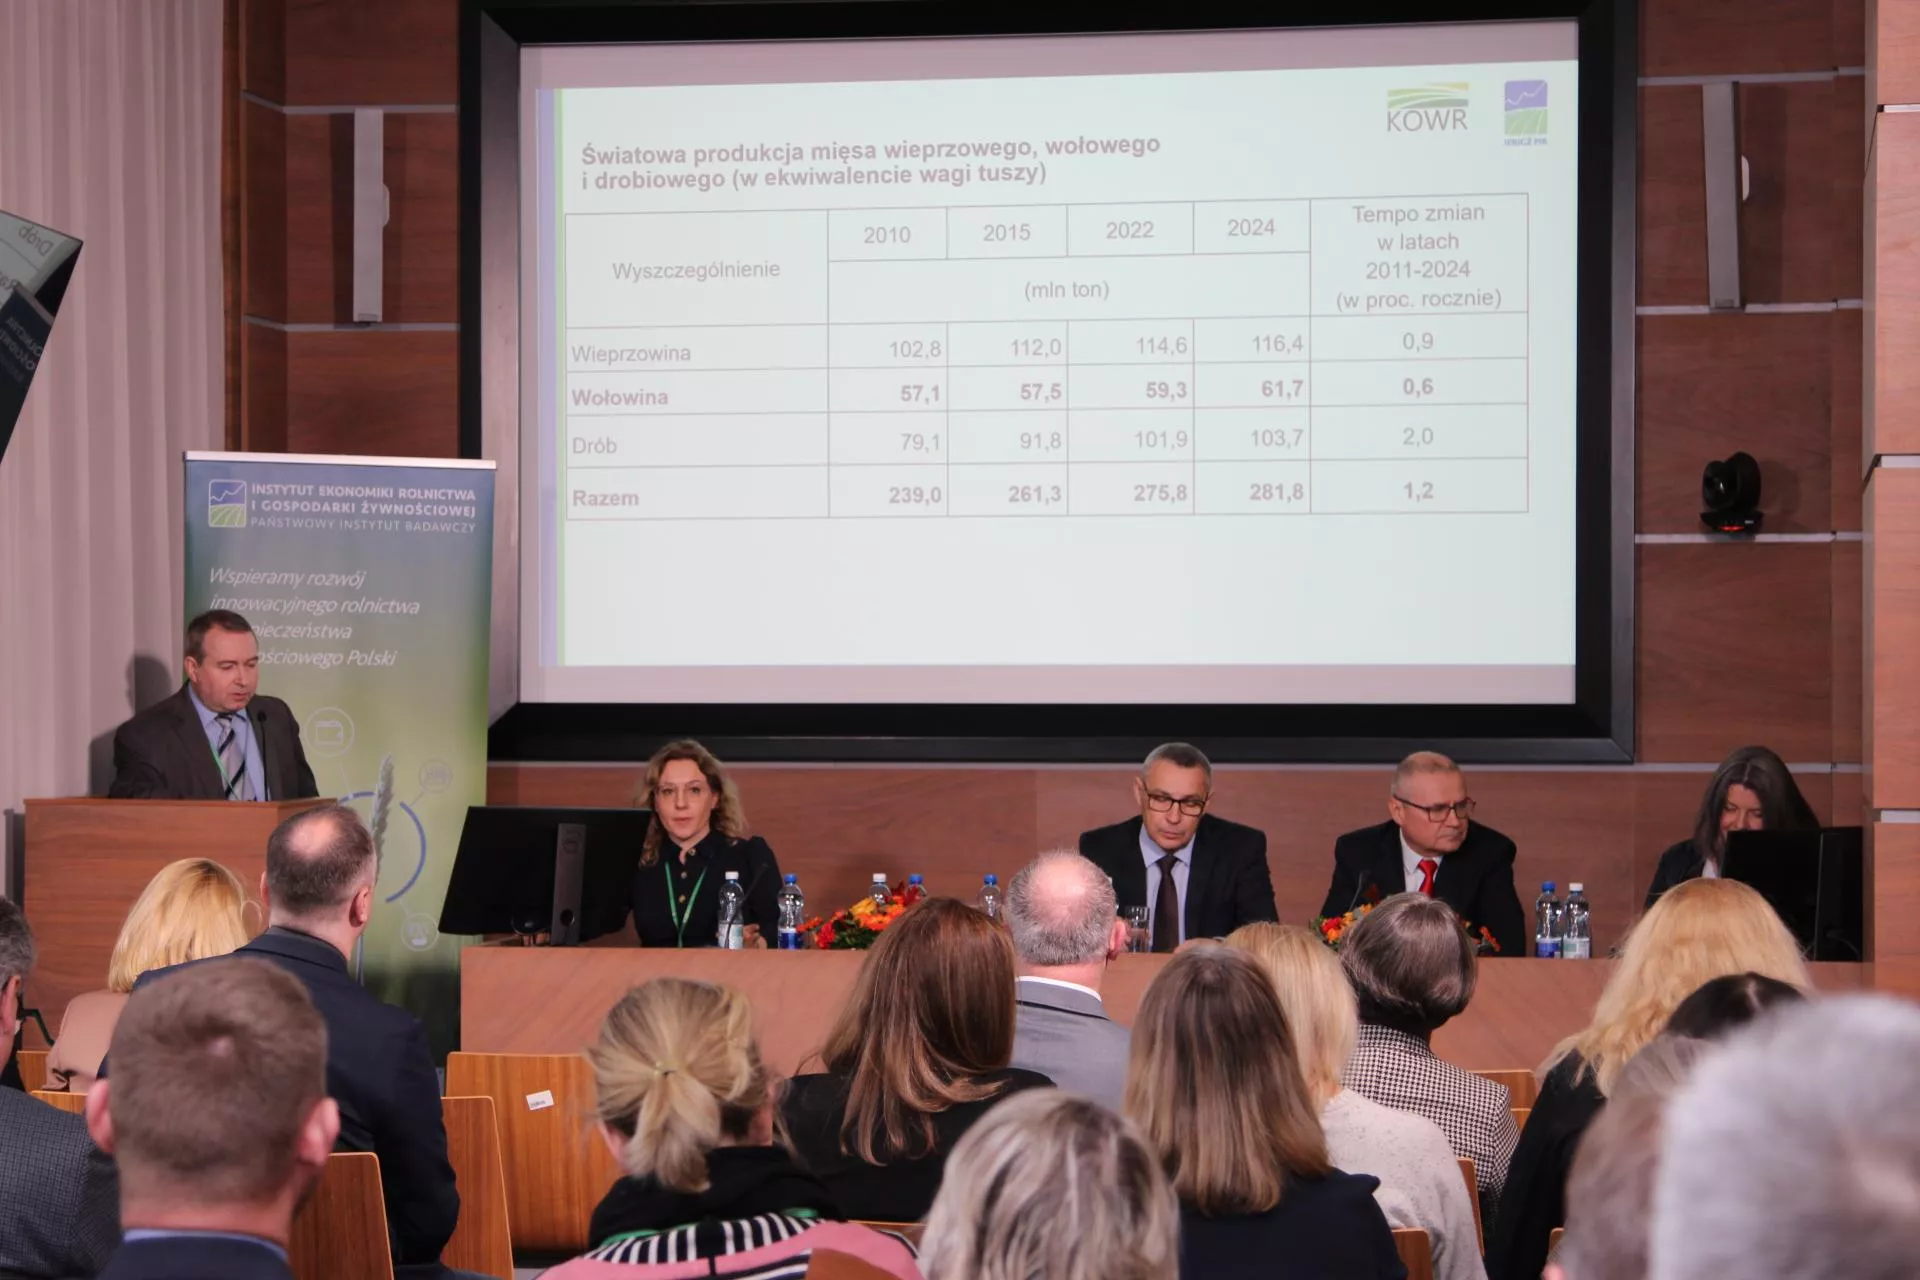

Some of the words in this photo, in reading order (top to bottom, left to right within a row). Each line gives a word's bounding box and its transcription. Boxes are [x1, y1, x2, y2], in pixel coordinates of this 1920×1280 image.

[1387, 109, 1468, 132] KOWR
[582, 141, 685, 165] Światowa
[694, 143, 804, 167] produkcja
[812, 141, 876, 162] mięsa
[884, 138, 1037, 162] wieprzowego,
[1046, 136, 1161, 157] wołowego
[582, 173, 588, 189] i
[595, 170, 725, 191] drobiowego
[733, 169, 758, 191] (w
[765, 167, 911, 186] ekwiwalencie
[920, 165, 971, 186] wagi
[978, 163, 1046, 186] tuszy)
[1353, 206, 1418, 226] Tempo
[1426, 205, 1485, 222] zmian
[864, 226, 910, 244] 2010
[983, 224, 1030, 241] 2015
[1106, 222, 1154, 239] 2022
[1227, 219, 1275, 236] 2024
[1378, 237, 1393, 251] w
[1400, 233, 1459, 251] latach
[612, 260, 780, 282] Wyszczególnienie
[1366, 261, 1470, 280] 2011-2024
[1024, 281, 1065, 302] (mln
[1072, 280, 1109, 300] ton)
[1337, 292, 1359, 312] (w
[1366, 291, 1415, 309] proc.
[1422, 288, 1502, 309] rocznie)
[889, 341, 942, 360] 102,8
[1011, 338, 1061, 359] 112,0
[1136, 337, 1187, 356] 114,6
[1252, 335, 1303, 354] 116,4
[1403, 333, 1434, 352] 0,9
[572, 344, 691, 365] Wieprzowina
[900, 385, 940, 404] 57,1
[1020, 383, 1061, 403] 57,5
[1146, 381, 1187, 400] 59,3
[1262, 380, 1303, 399] 61,7
[1403, 378, 1434, 397] 0,6
[572, 389, 669, 406] Wołowina
[572, 437, 617, 455] Drób
[901, 433, 940, 452] 79,1
[1019, 431, 1061, 452] 91,8
[1134, 431, 1188, 450] 101,9
[1250, 429, 1303, 449] 103,7
[1403, 427, 1434, 447] 2,0
[252, 484, 314, 496] INSTYTUT
[319, 485, 394, 498] EKONOMIKI
[399, 488, 475, 501] ROLNICTWA
[572, 489, 638, 507] Razem
[889, 486, 942, 505] 239,0
[1009, 486, 1061, 506] 261,3
[1134, 484, 1187, 502] 275,8
[1250, 483, 1303, 502] 281,8
[1404, 482, 1434, 500] 1,2
[252, 500, 256, 511] I
[262, 501, 355, 513] GOSPODARKI
[361, 501, 475, 518] ŻYWNOŚCIOWEJ
[251, 516, 334, 529] PAŃSTWOWY
[340, 519, 400, 531] INSTYTUT
[406, 521, 475, 533] BADAWCZY
[209, 568, 302, 589] Wspieramy
[307, 572, 366, 589] rozwój
[209, 594, 337, 616] innowacyjnego
[341, 597, 420, 615] rolnictwa
[347, 650, 398, 667] Polski
